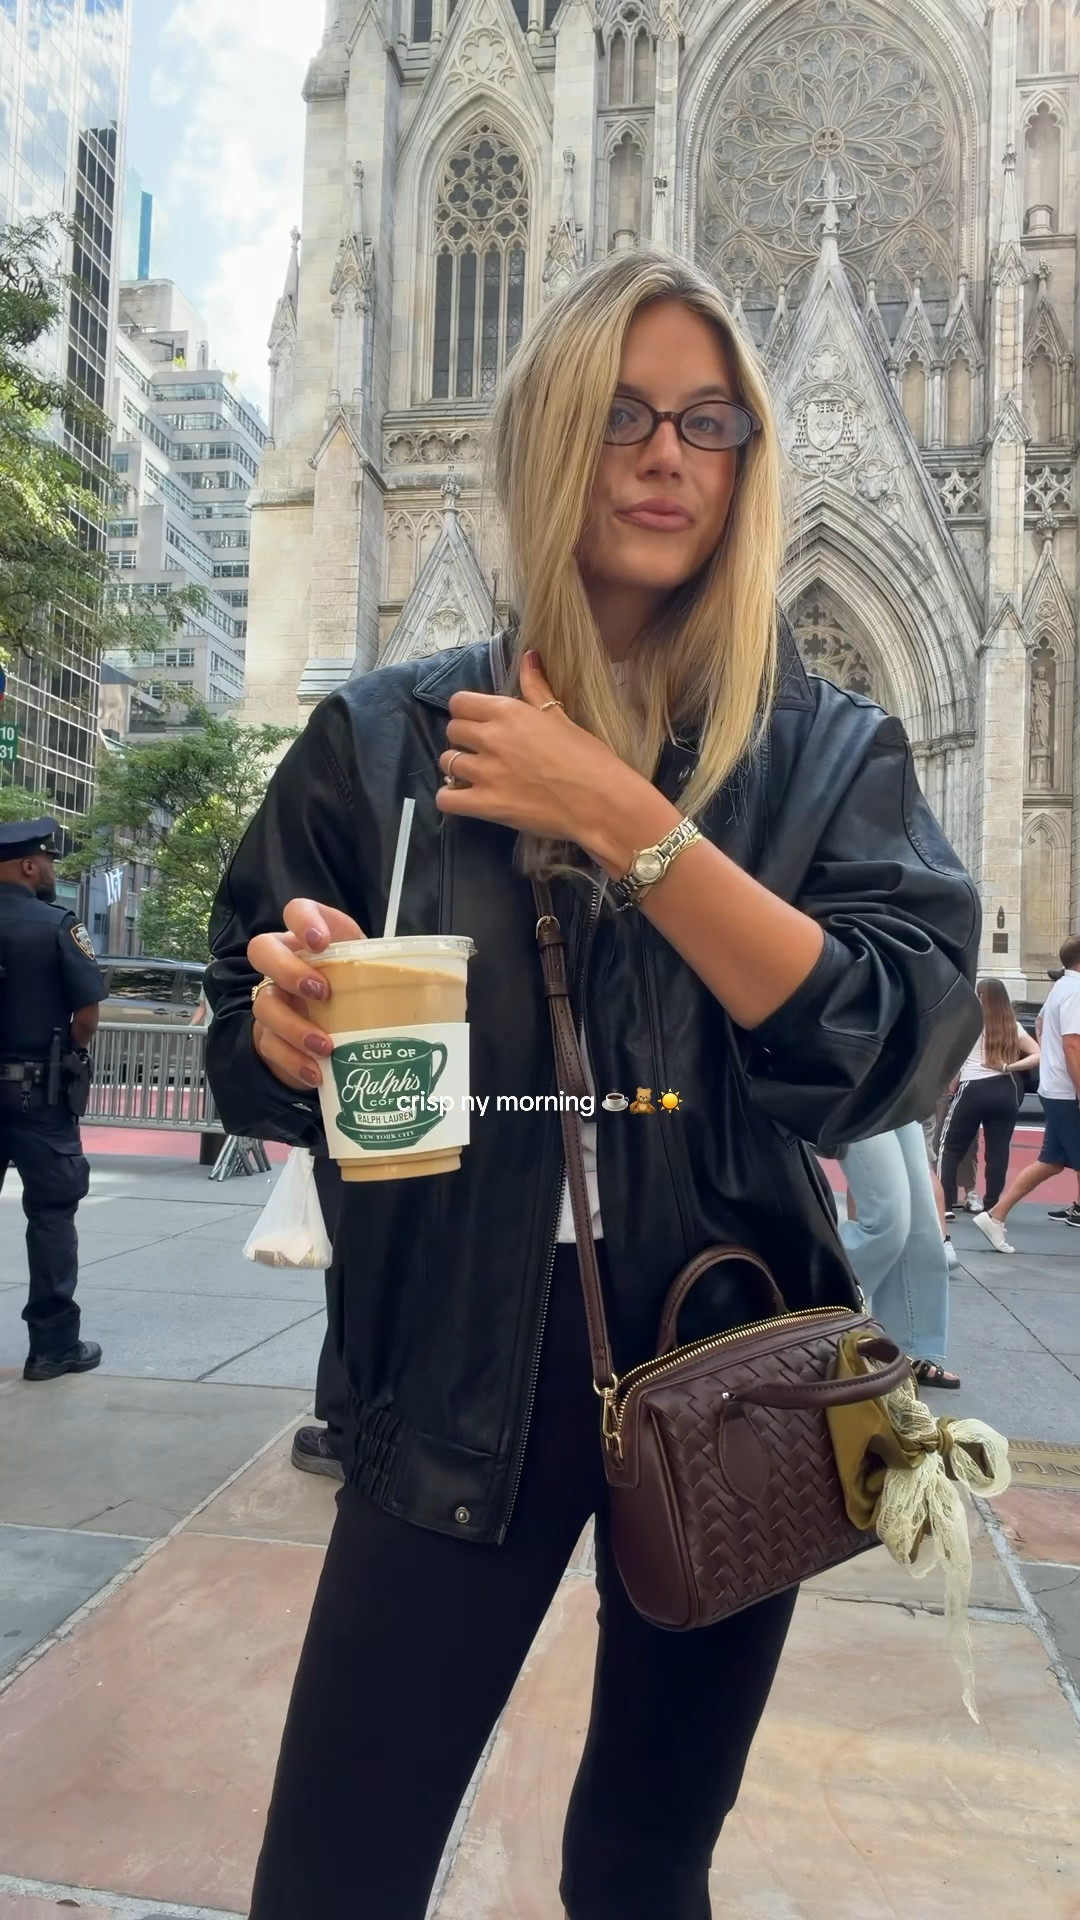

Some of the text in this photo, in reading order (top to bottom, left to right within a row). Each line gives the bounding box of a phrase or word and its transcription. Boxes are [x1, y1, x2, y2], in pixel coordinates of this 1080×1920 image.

[363, 1042, 392, 1050] ENJOY
[347, 1048, 417, 1062] A CUP OF
[341, 1068, 420, 1112] Ralph's
[357, 1111, 414, 1124] RALPH LAUREN
[376, 1132, 396, 1140] YORK
